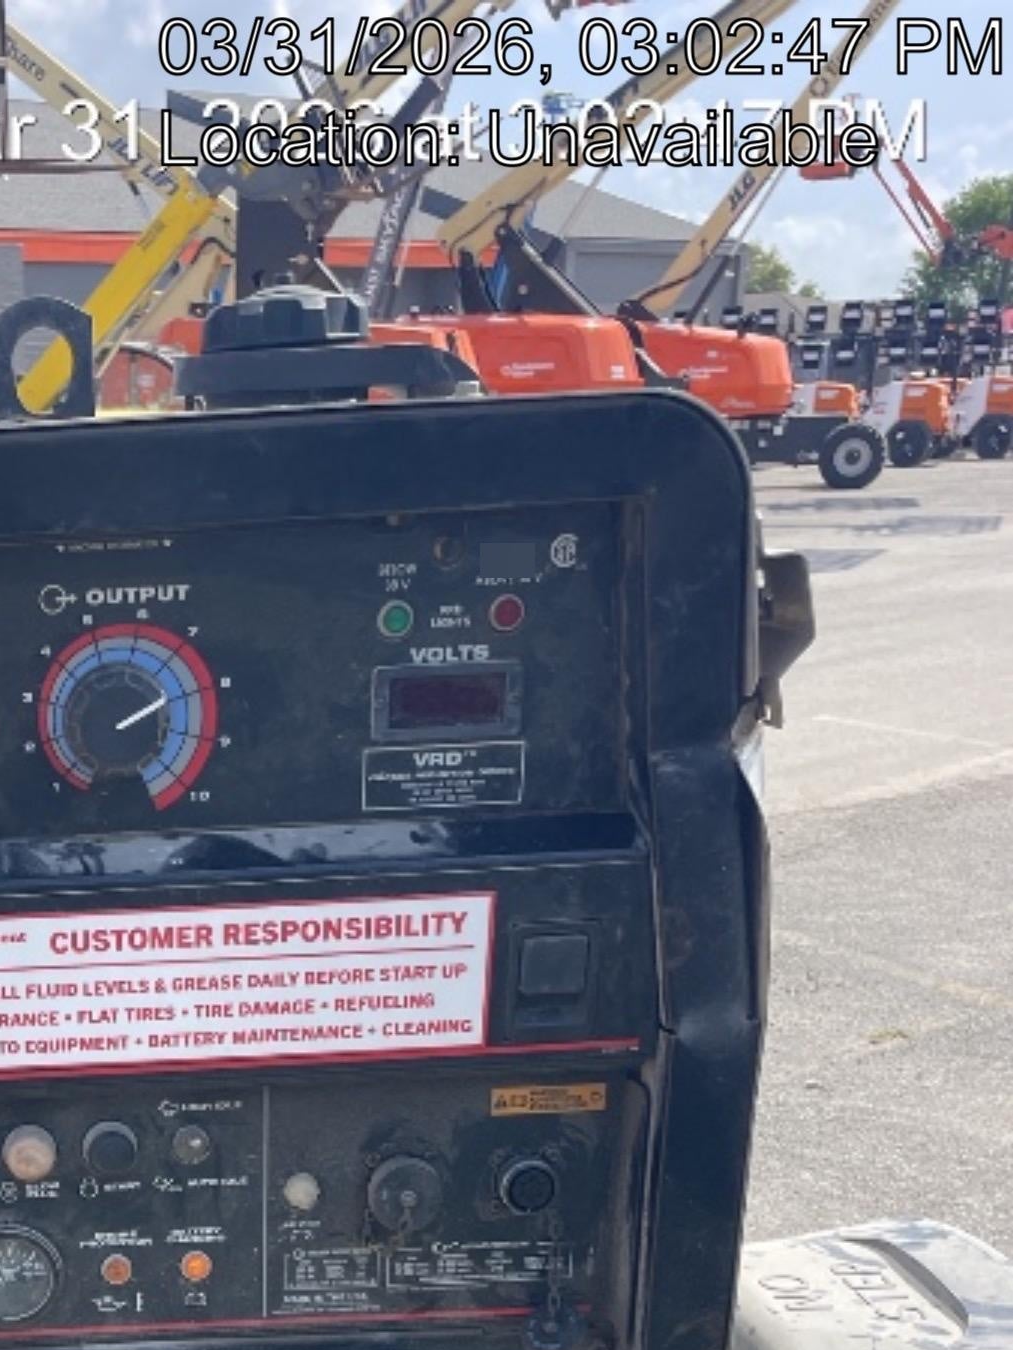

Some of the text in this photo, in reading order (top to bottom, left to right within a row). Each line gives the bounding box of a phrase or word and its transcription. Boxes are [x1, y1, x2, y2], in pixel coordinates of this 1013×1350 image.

[85, 584, 190, 605] OUTPUT
[409, 644, 490, 663] VOLTS
[50, 912, 468, 955] CUSTOMER RESPONSIBILITY
[26, 983, 77, 998] FLUID
[83, 979, 149, 996] LEVELS
[154, 978, 167, 993] &
[173, 975, 243, 992] GREASE
[248, 971, 299, 988] DAILY
[305, 968, 375, 985] BEFORE
[380, 965, 437, 981] START
[442, 962, 467, 978] UP
[77, 1009, 118, 1024] FLAT
[125, 1006, 175, 1022] TIRES
[194, 1003, 233, 1018] TIRE
[239, 999, 315, 1017] DAMAGE
[334, 993, 435, 1012] REFUELING
[26, 1035, 129, 1054] EQUIPMENT
[148, 1031, 228, 1048] BATTERY
[232, 1025, 362, 1045] MAINTENANCE
[382, 1019, 473, 1036] CLEANING
